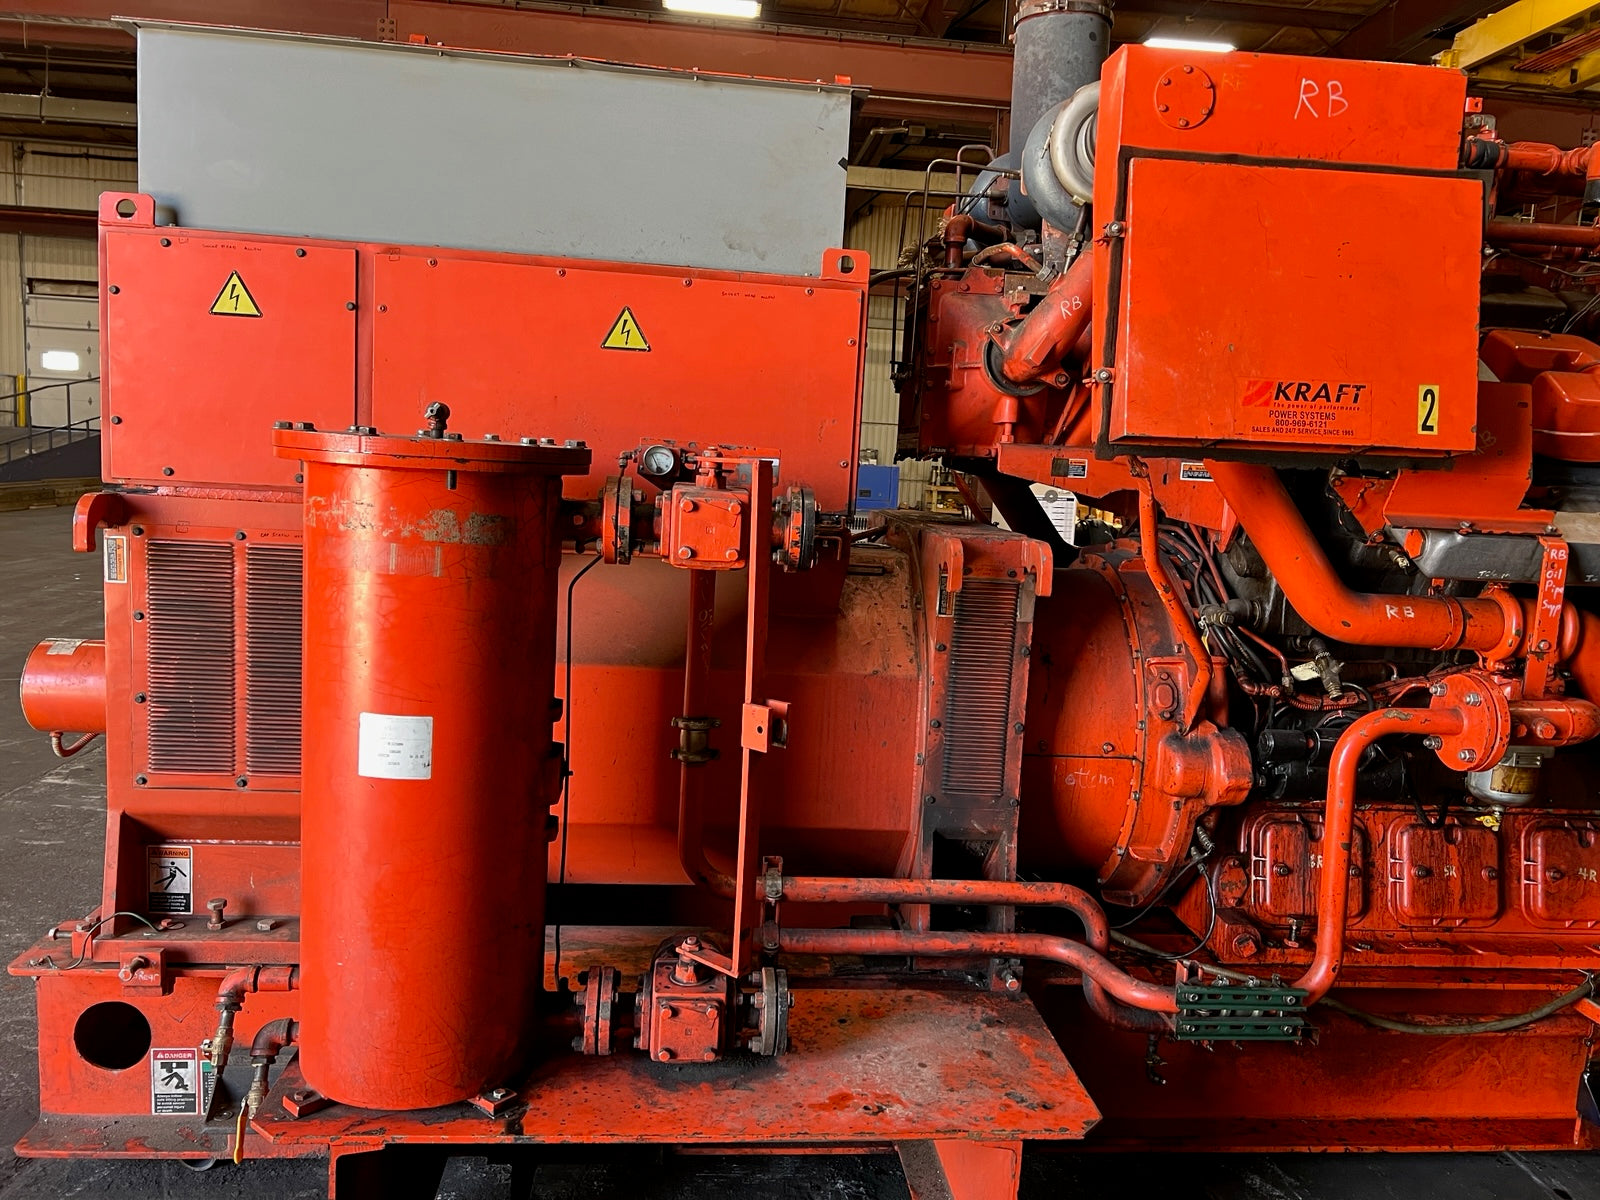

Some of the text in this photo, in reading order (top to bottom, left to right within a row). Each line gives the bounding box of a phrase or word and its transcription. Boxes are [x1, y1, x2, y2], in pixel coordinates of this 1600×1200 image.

[1294, 77, 1349, 120] RB
[1060, 295, 1083, 320] RB
[1274, 381, 1367, 405] KRAFT
[1319, 404, 1361, 412] performance
[1421, 388, 1436, 432] 2
[1269, 410, 1336, 422] POWER SYSTEMS
[1275, 419, 1328, 429] 800-969-6121
[1251, 426, 1271, 434] SALES
[1285, 427, 1296, 435] 24/7
[1323, 429, 1341, 437] SINCE
[1550, 549, 1568, 561] RB
[1546, 568, 1563, 580] Oil
[1578, 867, 1598, 884] 4R
